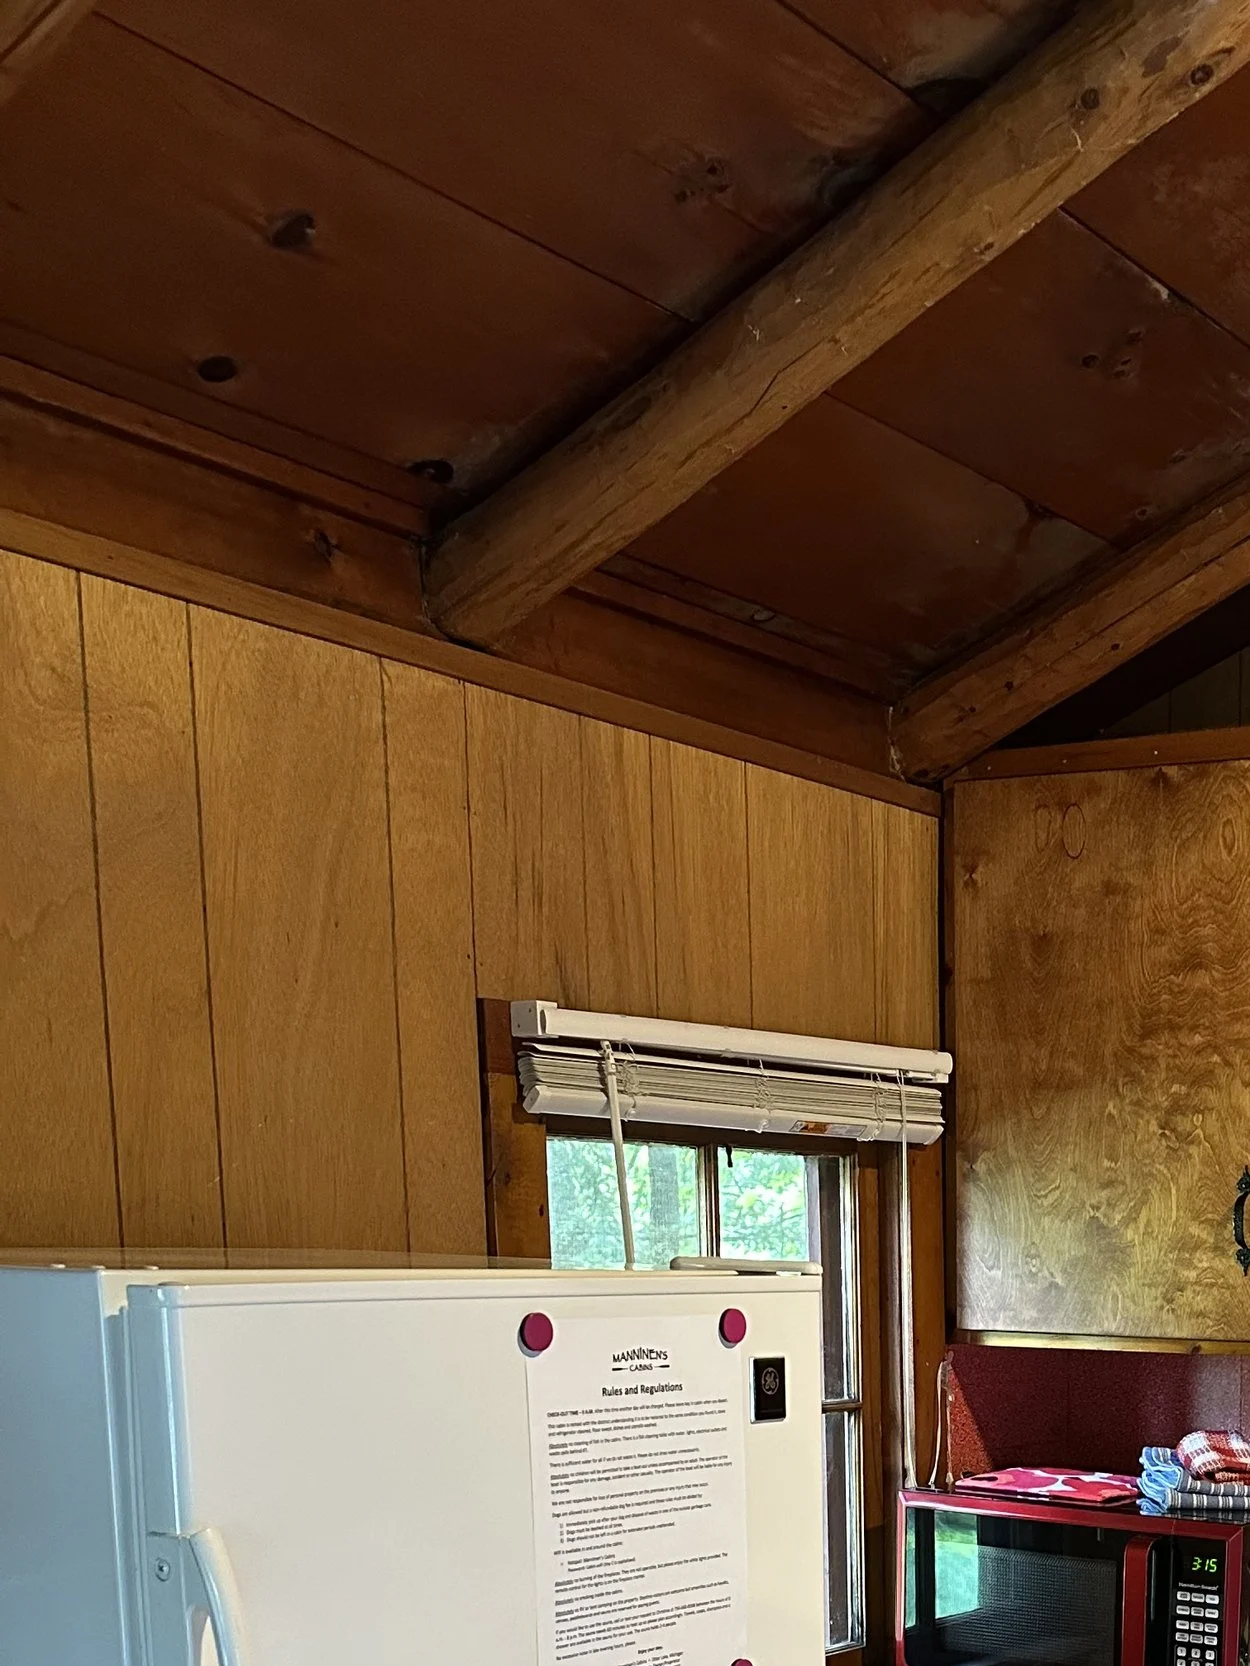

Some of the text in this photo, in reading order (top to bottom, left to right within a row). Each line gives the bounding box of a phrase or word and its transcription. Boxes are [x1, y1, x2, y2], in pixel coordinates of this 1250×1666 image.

[602, 1382, 683, 1396] Rules and Regulations
